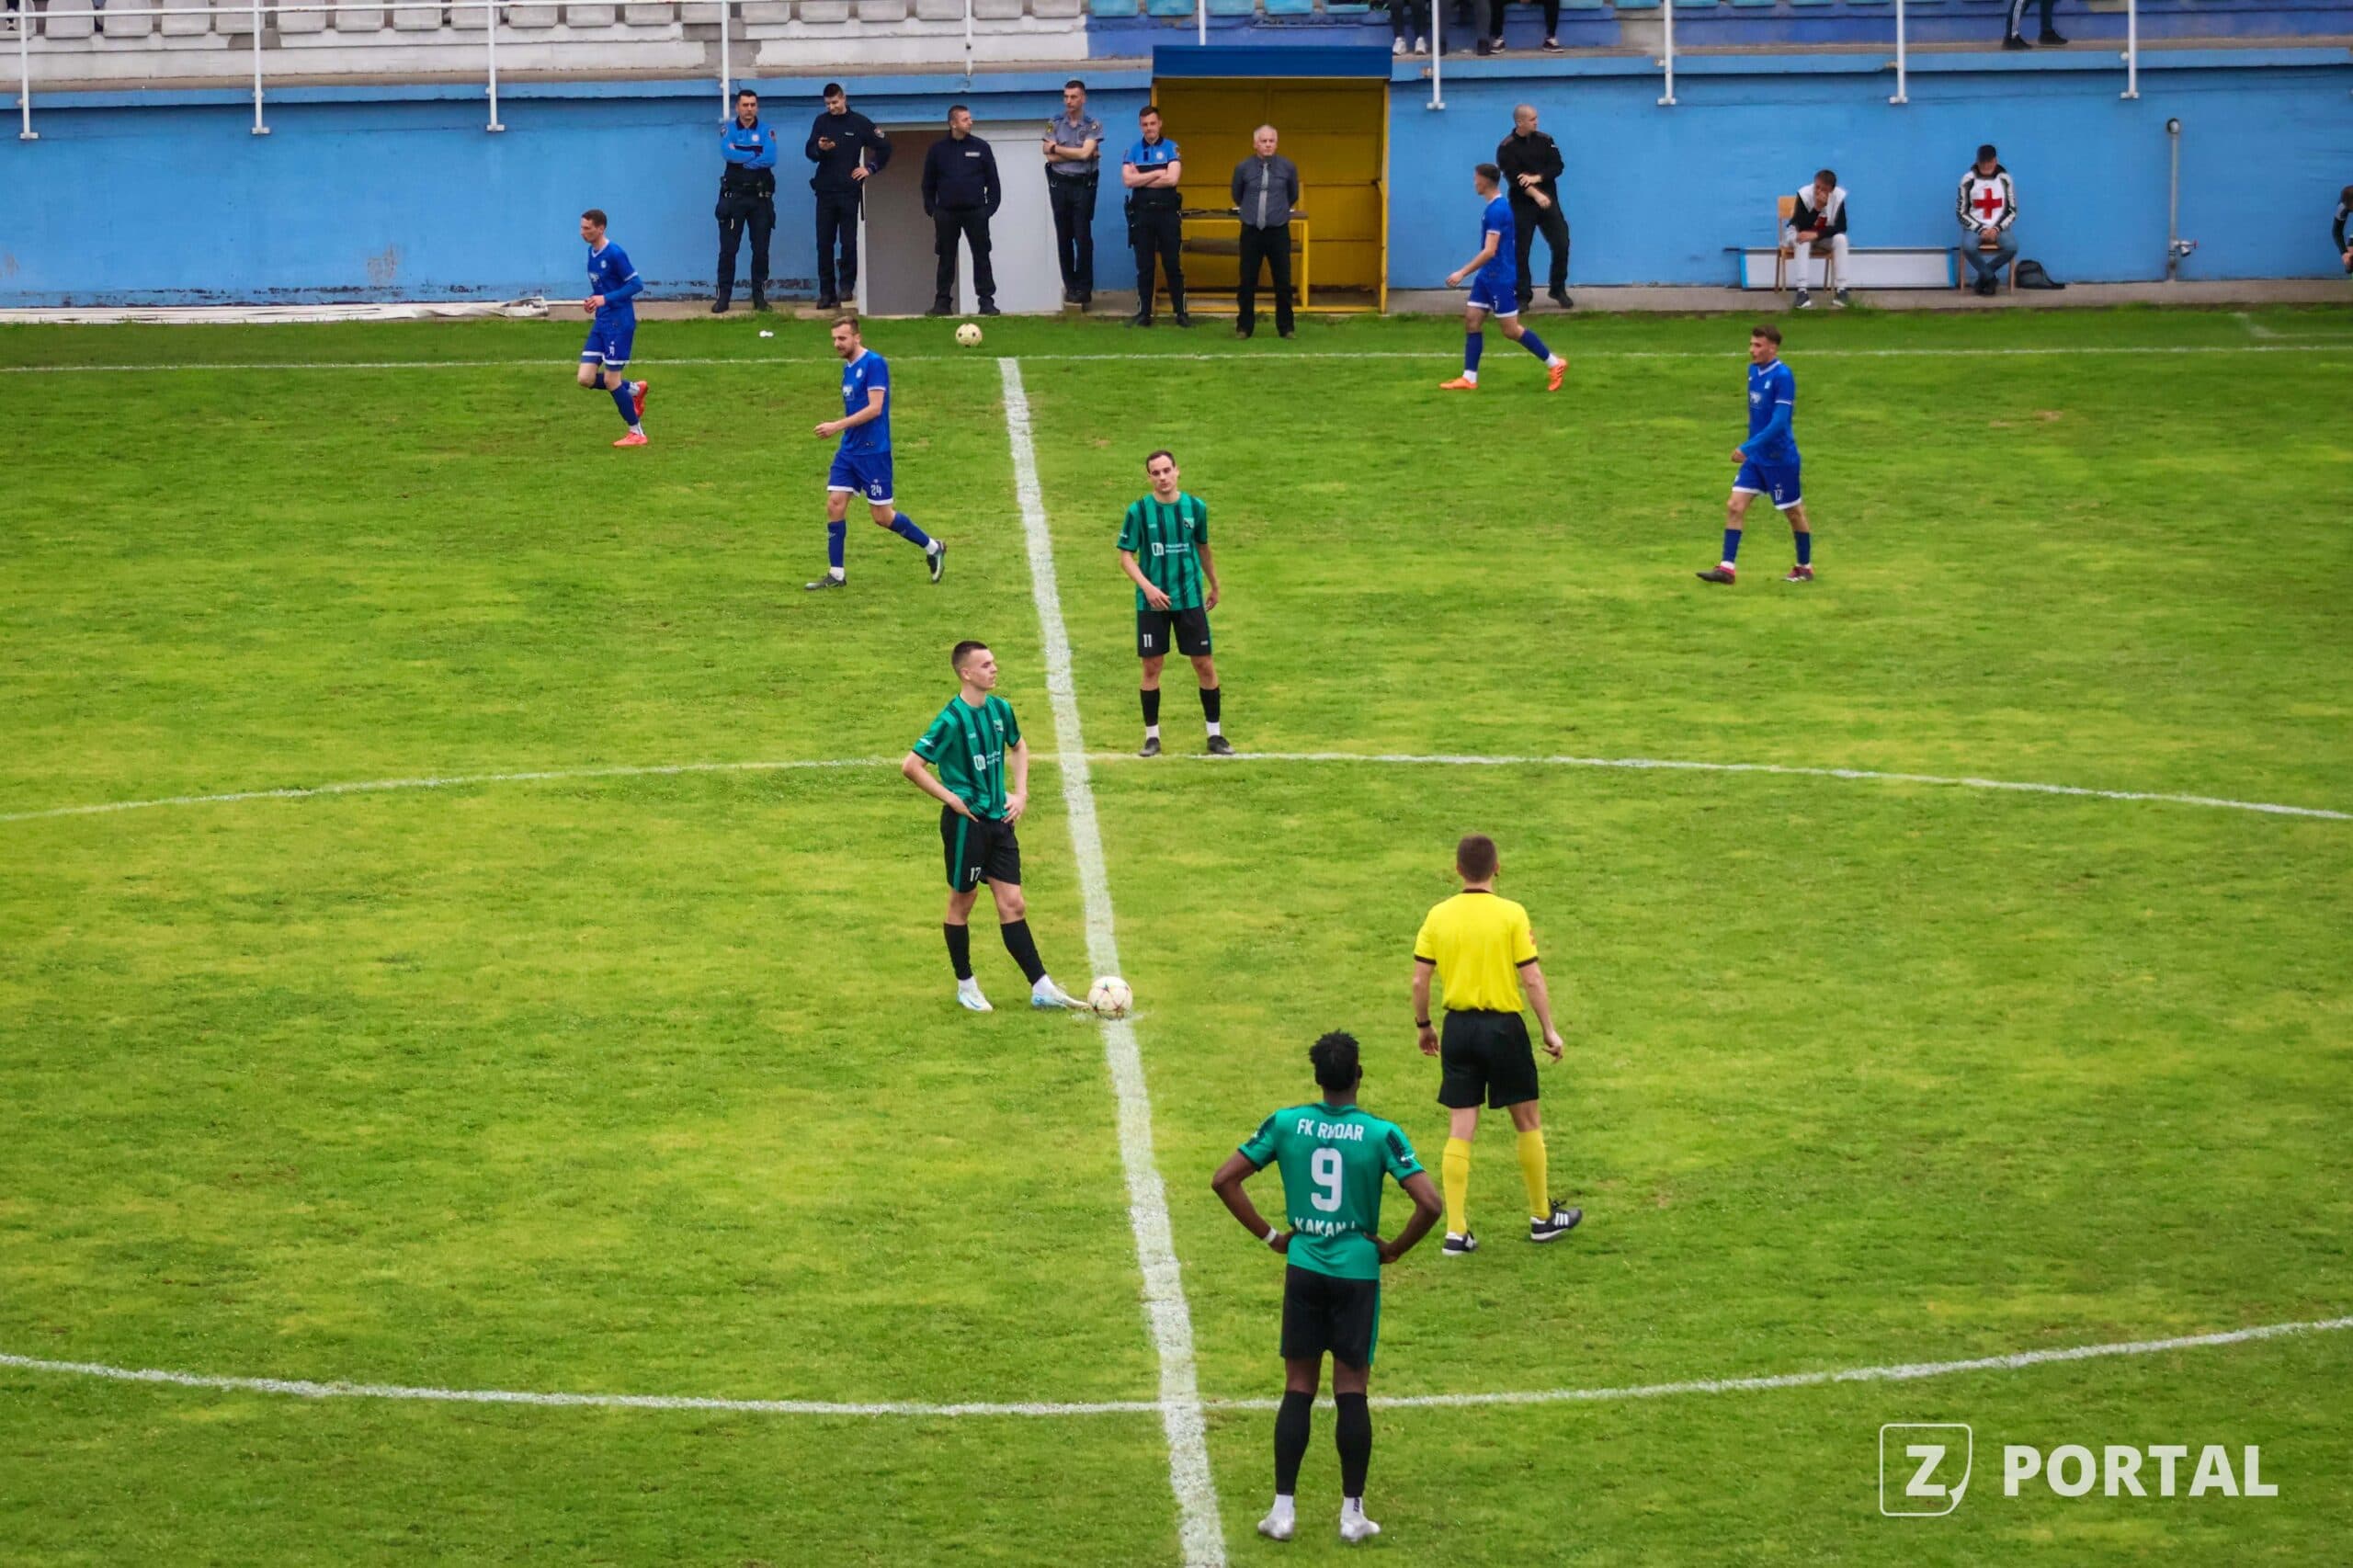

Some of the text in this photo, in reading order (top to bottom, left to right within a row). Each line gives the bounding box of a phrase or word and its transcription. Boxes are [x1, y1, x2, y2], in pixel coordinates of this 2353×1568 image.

[870, 484, 882, 496] 24
[1142, 633, 1153, 648] 11
[970, 867, 982, 882] 17
[1296, 1118, 1315, 1136] FK
[1311, 1147, 1343, 1212] 9
